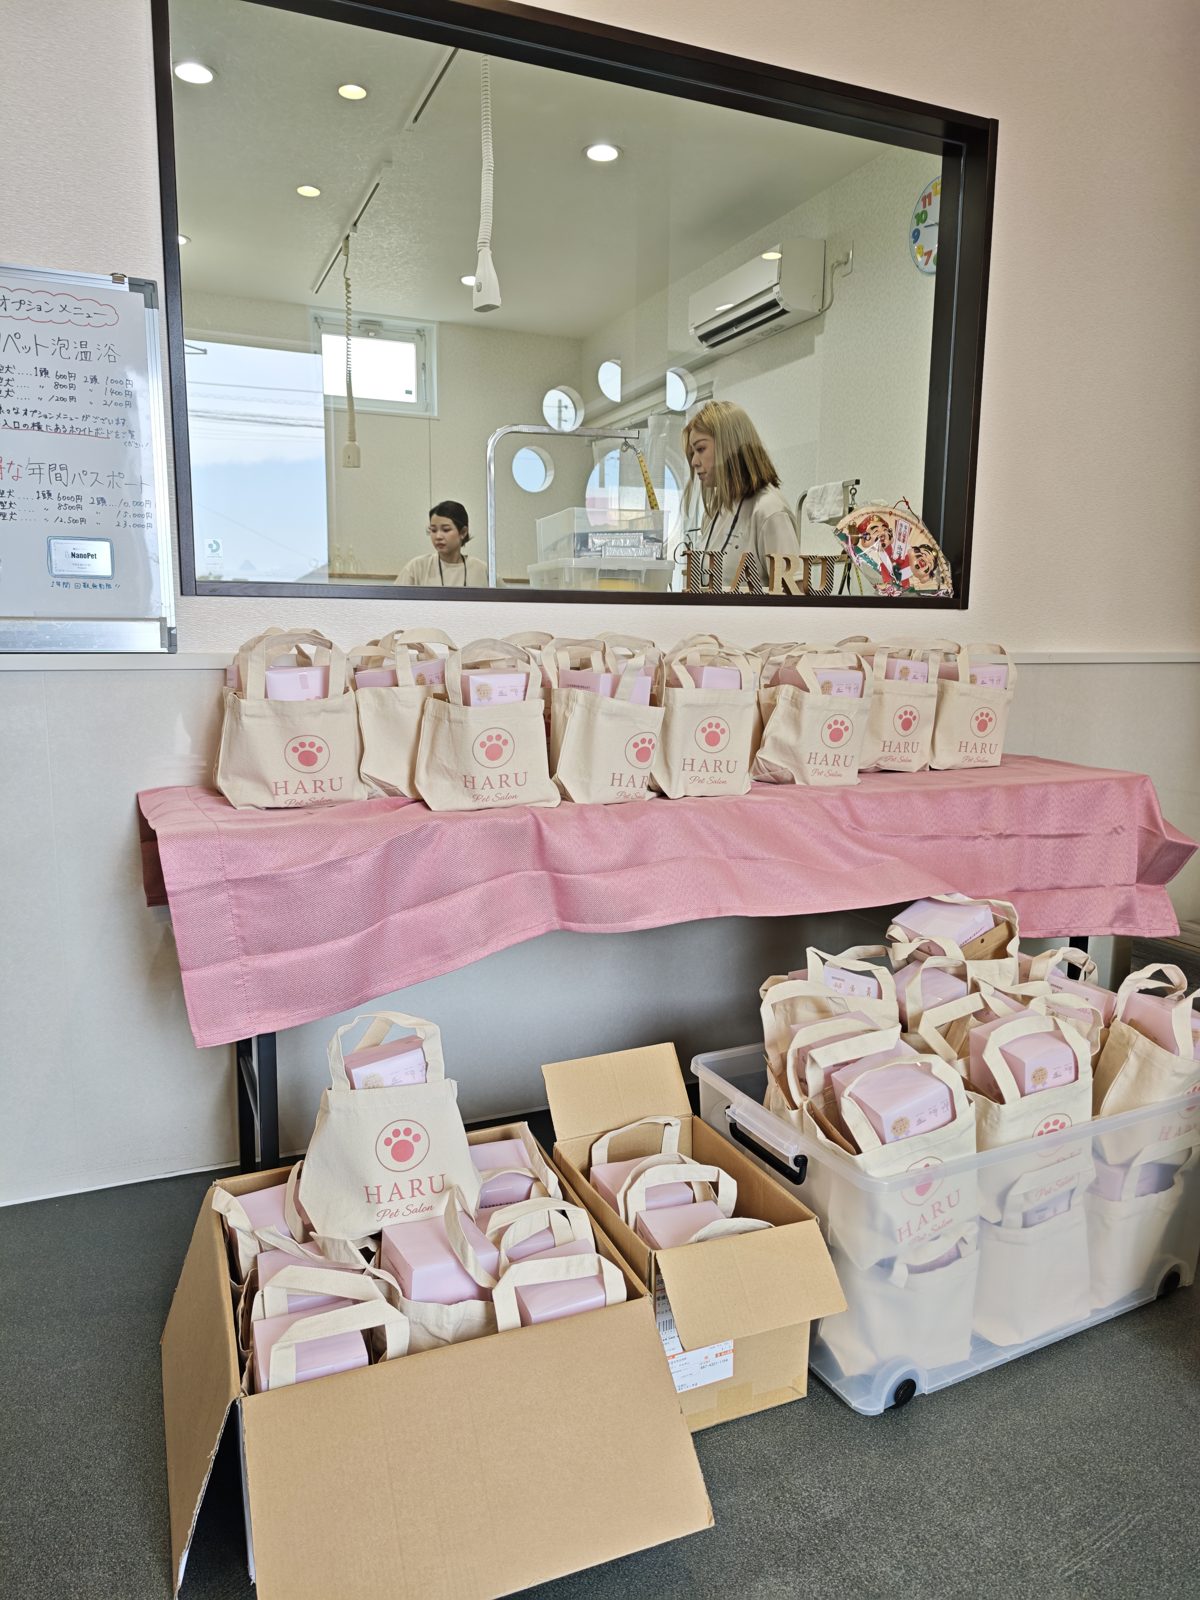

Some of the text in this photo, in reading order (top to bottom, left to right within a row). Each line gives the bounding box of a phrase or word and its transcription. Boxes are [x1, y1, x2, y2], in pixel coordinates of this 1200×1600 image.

[921, 192, 932, 209] 11
[914, 209, 928, 226] 10
[911, 228, 921, 244] 9
[923, 249, 933, 266] 7
[0, 295, 108, 318] オプションメニュー
[53, 381, 77, 390] 800円
[55, 370, 77, 382] 600円
[105, 376, 133, 388] 1000円
[57, 492, 83, 503] 6000円
[70, 551, 98, 560] NanoPet
[683, 550, 839, 596] HARU
[881, 741, 920, 754] HARU
[959, 741, 998, 755] HARU
[682, 758, 738, 774] HARU
[807, 752, 854, 768] HARU
[272, 776, 343, 796] HARU
[462, 771, 528, 790] HARU
[363, 1173, 446, 1204] HARU
[376, 1202, 433, 1222] Pet Salon
[896, 1188, 960, 1242] HARU
